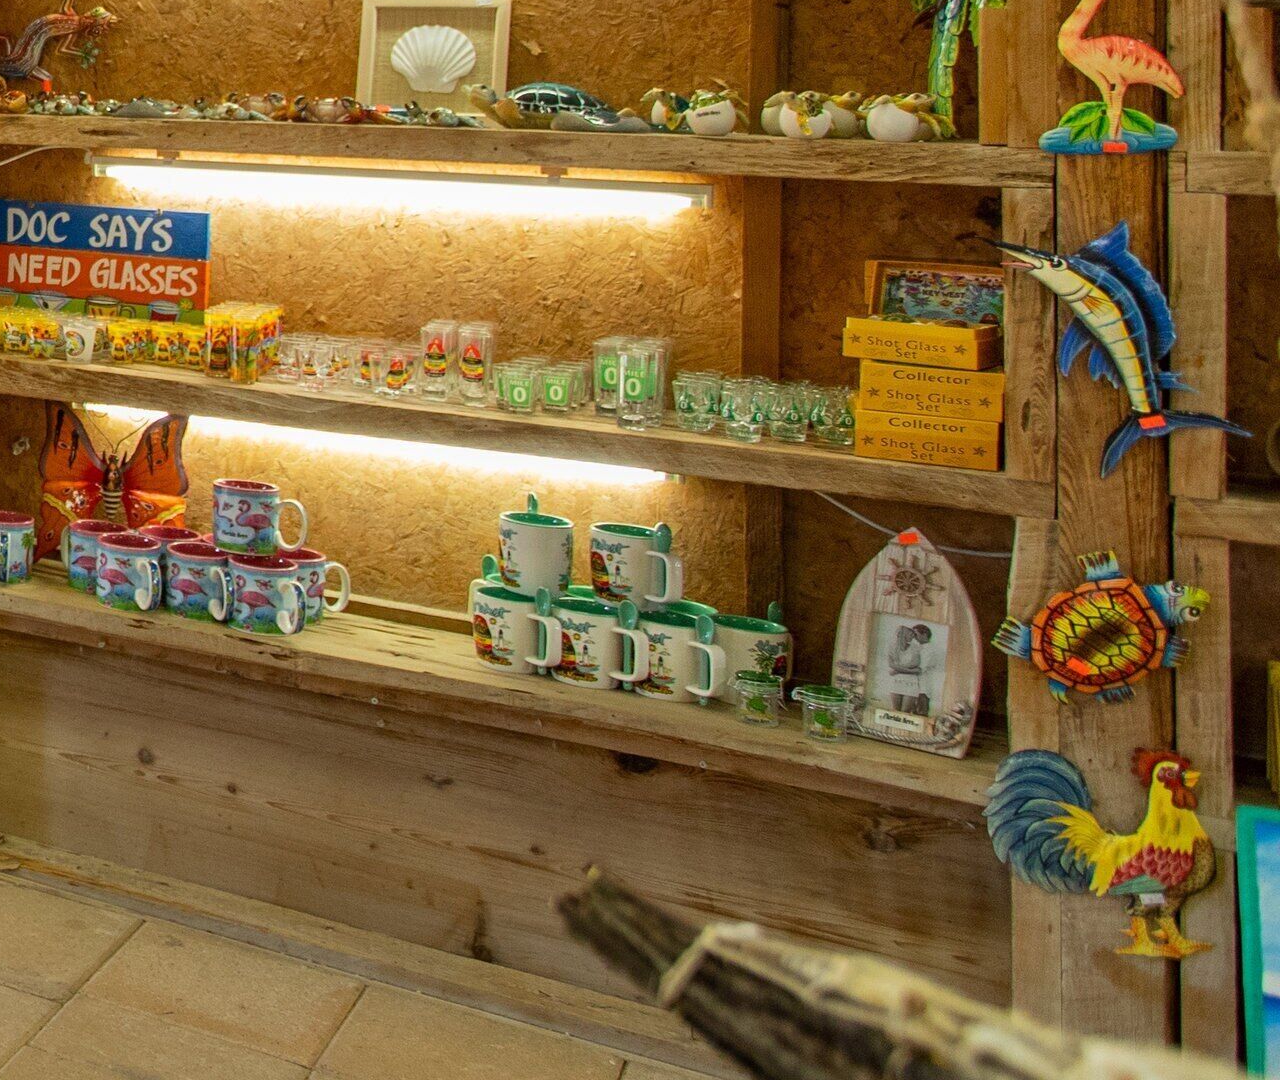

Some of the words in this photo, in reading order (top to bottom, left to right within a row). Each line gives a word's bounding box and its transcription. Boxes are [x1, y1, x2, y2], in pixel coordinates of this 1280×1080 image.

[6, 207, 69, 244] DOC
[88, 213, 174, 253] SAYS
[8, 250, 82, 287] NEED
[89, 258, 198, 297] GLASSES
[867, 335, 899, 348] Shot
[905, 340, 947, 353] Glass
[895, 348, 918, 359] Set
[601, 358, 616, 366] MIL
[604, 367, 617, 384] 0
[893, 370, 971, 385] Collector
[513, 387, 527, 402] 0
[549, 385, 563, 401] 0
[626, 379, 640, 396] 0
[886, 389, 920, 402] Shot
[928, 393, 971, 406] Glass
[916, 401, 940, 413] Set
[889, 417, 967, 433] Collector
[880, 437, 915, 450] Shot
[922, 442, 965, 455] Glass
[910, 449, 934, 461] Set
